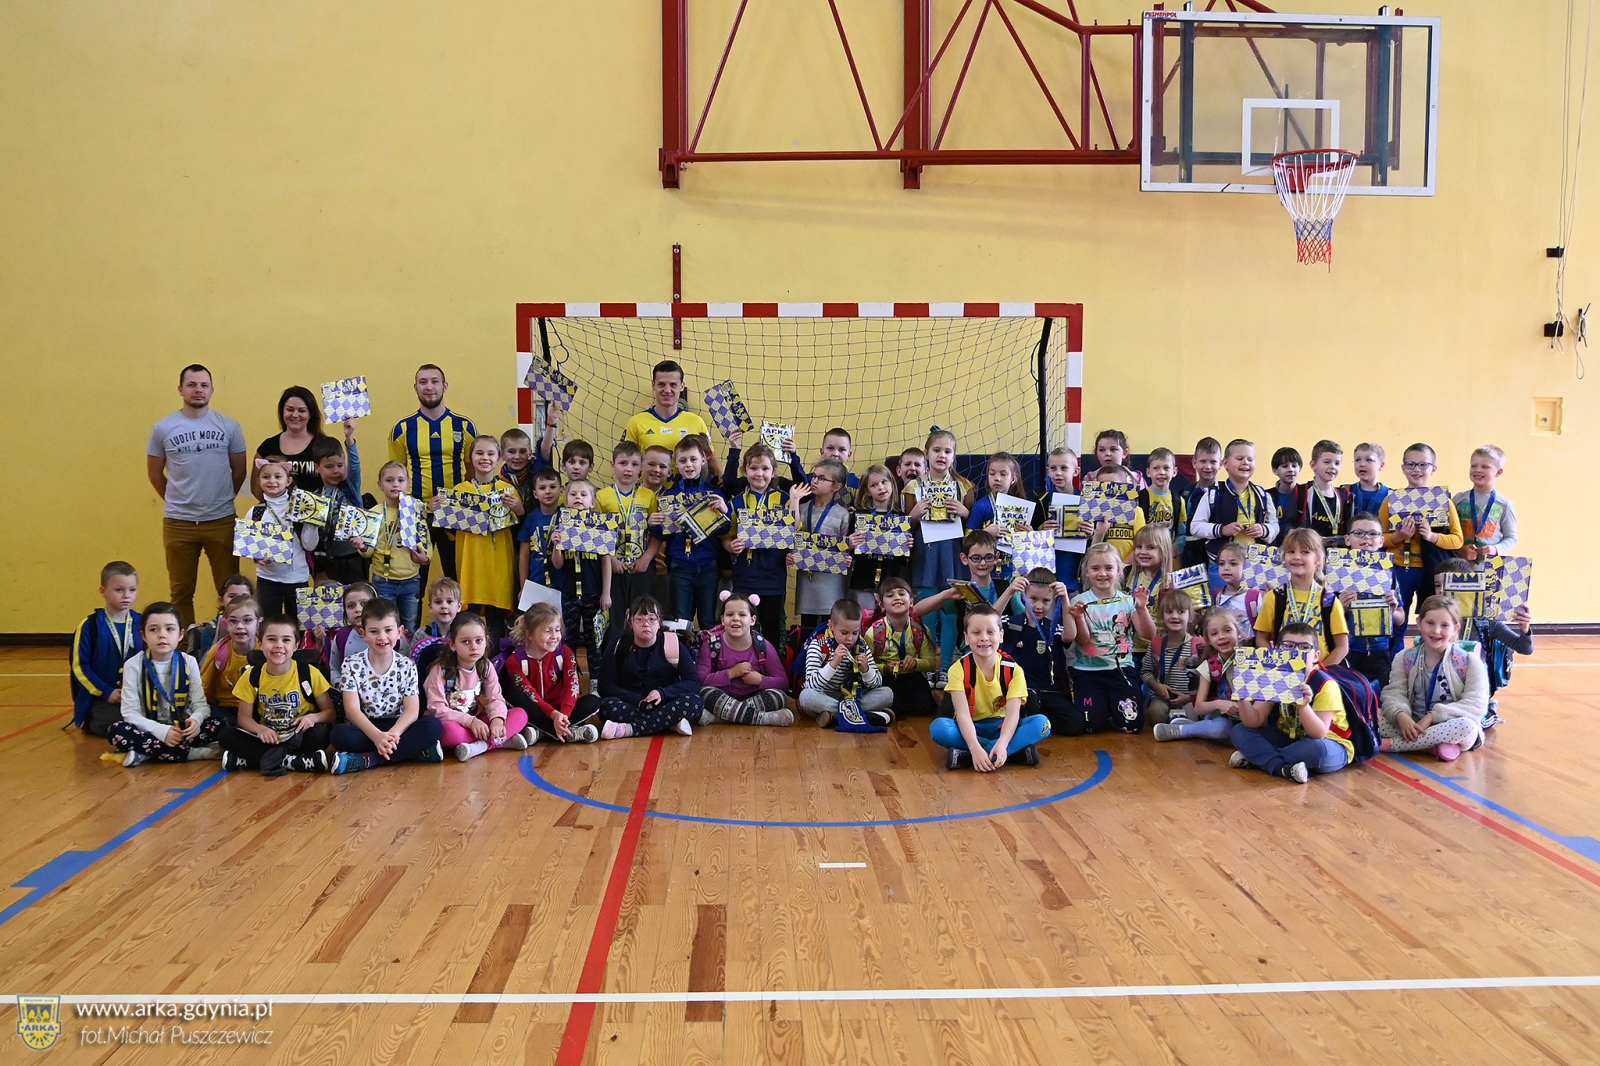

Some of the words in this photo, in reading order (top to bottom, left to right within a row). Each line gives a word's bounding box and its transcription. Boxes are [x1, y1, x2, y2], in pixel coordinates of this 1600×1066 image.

[169, 430, 197, 447] LUDZIE
[199, 430, 225, 442] MORZA
[926, 486, 953, 494] ARKA
[293, 493, 302, 518] ARKA
[343, 509, 354, 535] ARKA
[1001, 512, 1024, 520] ARKA
[1115, 529, 1132, 538] COOL
